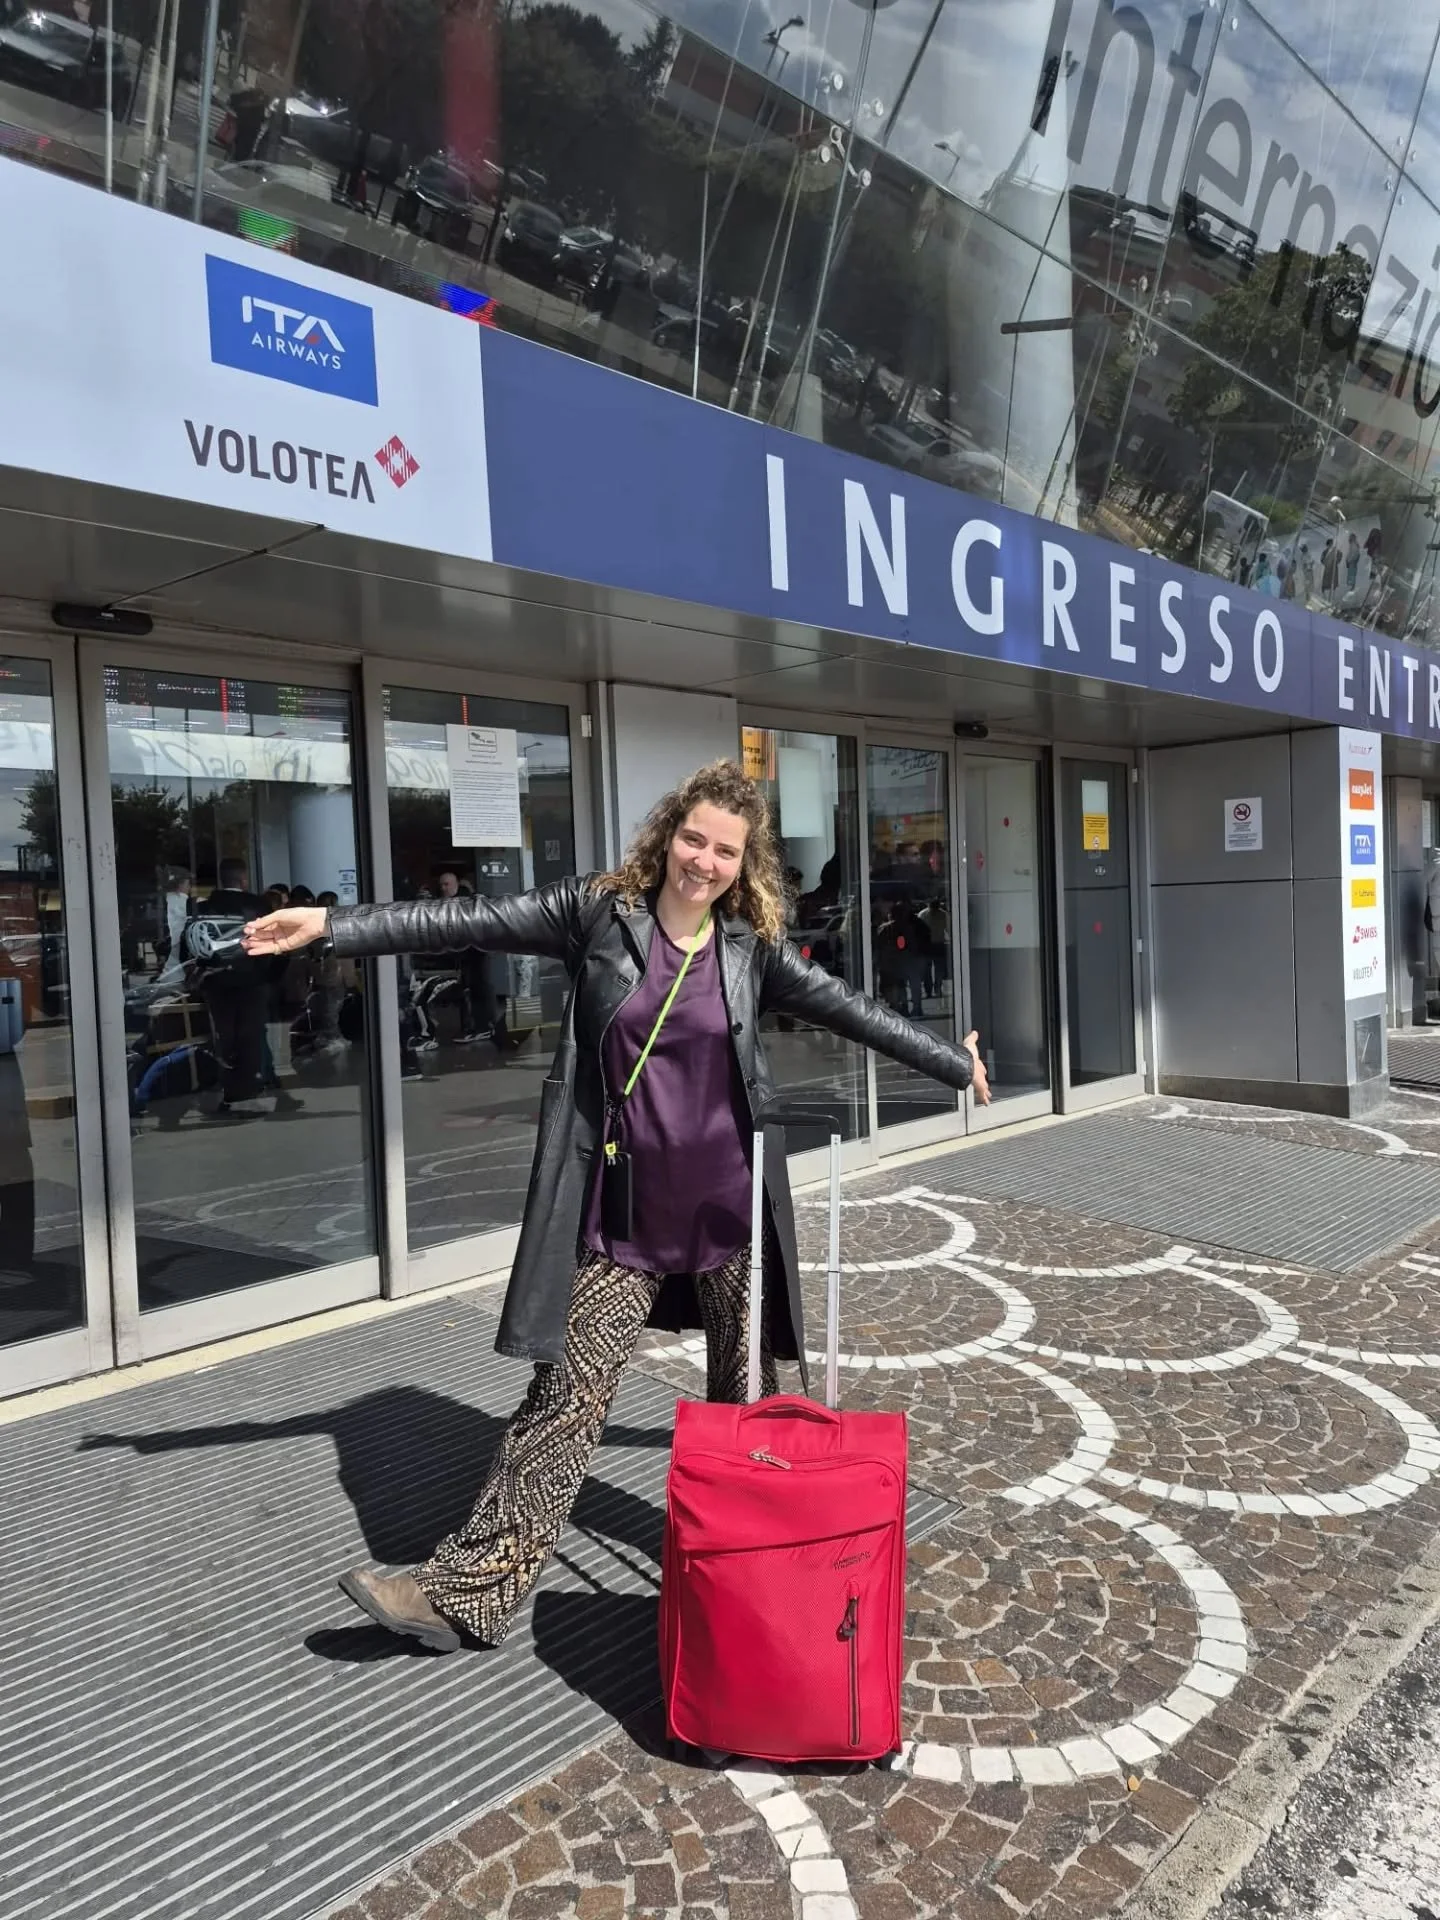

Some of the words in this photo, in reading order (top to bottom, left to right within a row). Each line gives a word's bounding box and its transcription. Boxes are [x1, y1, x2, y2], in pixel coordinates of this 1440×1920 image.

[242, 296, 345, 353] ITA
[251, 332, 341, 370] AIRWAYS
[184, 419, 375, 504] VOLOTEA
[766, 454, 1284, 692] INGRESSO
[1360, 926, 1378, 940] SWISS
